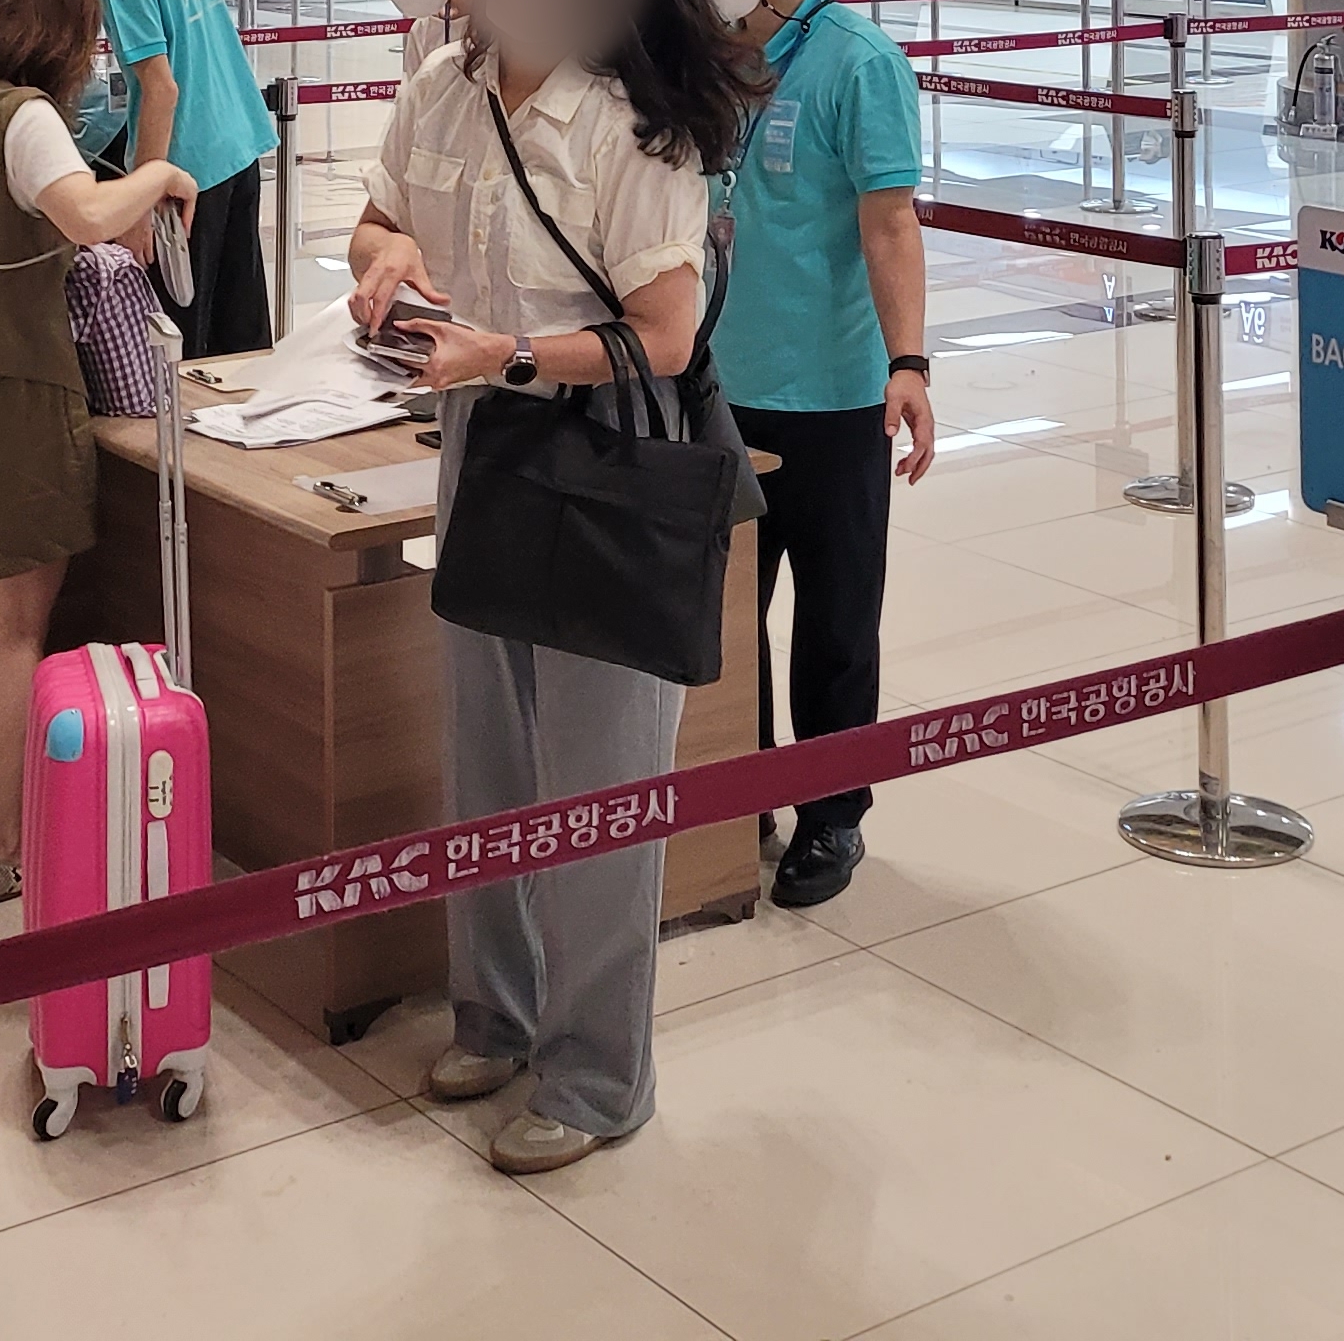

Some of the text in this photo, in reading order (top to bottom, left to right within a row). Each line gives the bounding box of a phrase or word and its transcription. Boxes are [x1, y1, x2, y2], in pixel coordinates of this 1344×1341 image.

[1190, 21, 1213, 33] KAC
[1287, 16, 1309, 27] KAC
[327, 24, 355, 37] KAC
[953, 39, 978, 52] KAC
[1058, 32, 1082, 45] KAC
[922, 74, 949, 91] KAC
[332, 85, 366, 100] KAC
[1038, 89, 1066, 105] KAC
[909, 660, 1197, 767] KAC 한국공항공사
[295, 783, 680, 919] KAC 한국공항공사
